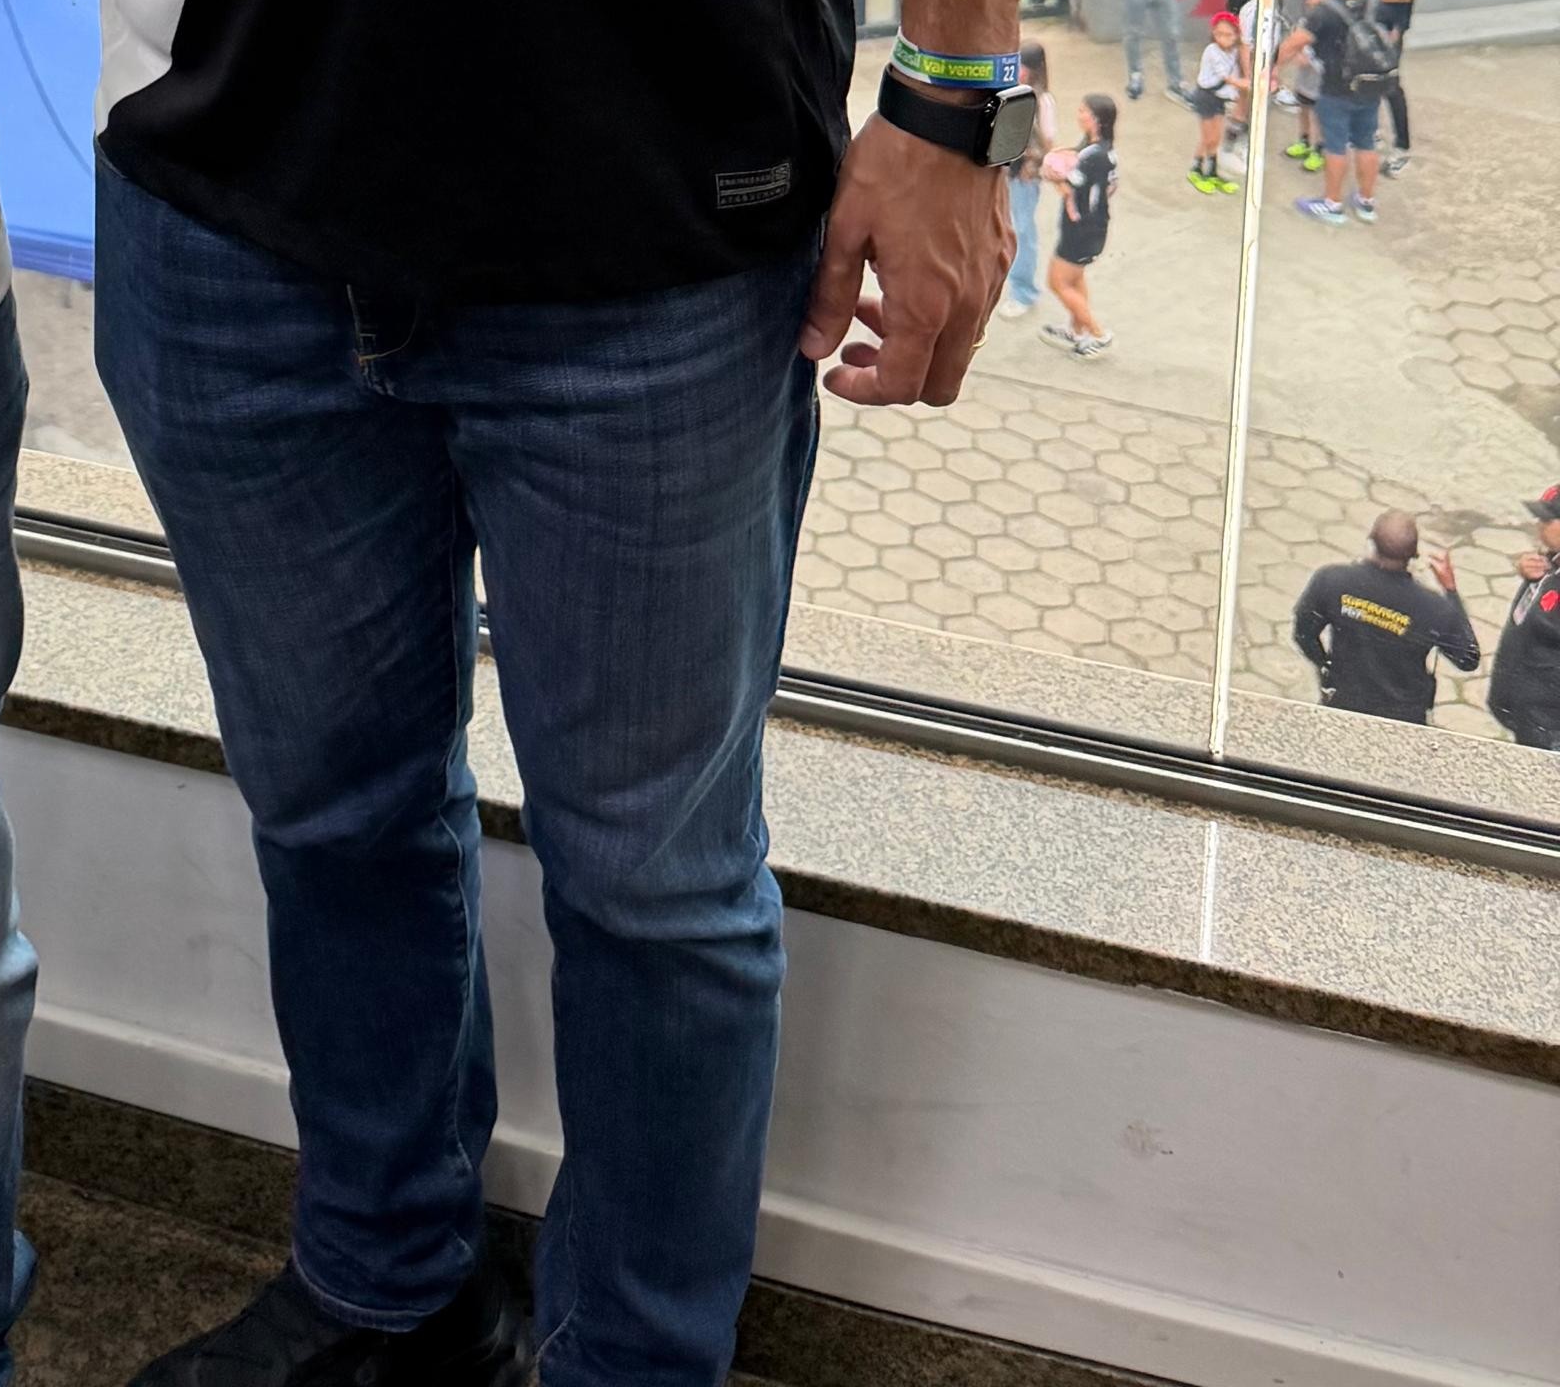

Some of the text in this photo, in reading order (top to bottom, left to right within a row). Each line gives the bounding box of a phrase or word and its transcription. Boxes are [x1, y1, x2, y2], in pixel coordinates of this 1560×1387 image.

[922, 59, 945, 74] vai
[947, 63, 991, 77] vencer
[1002, 65, 1015, 83] 22
